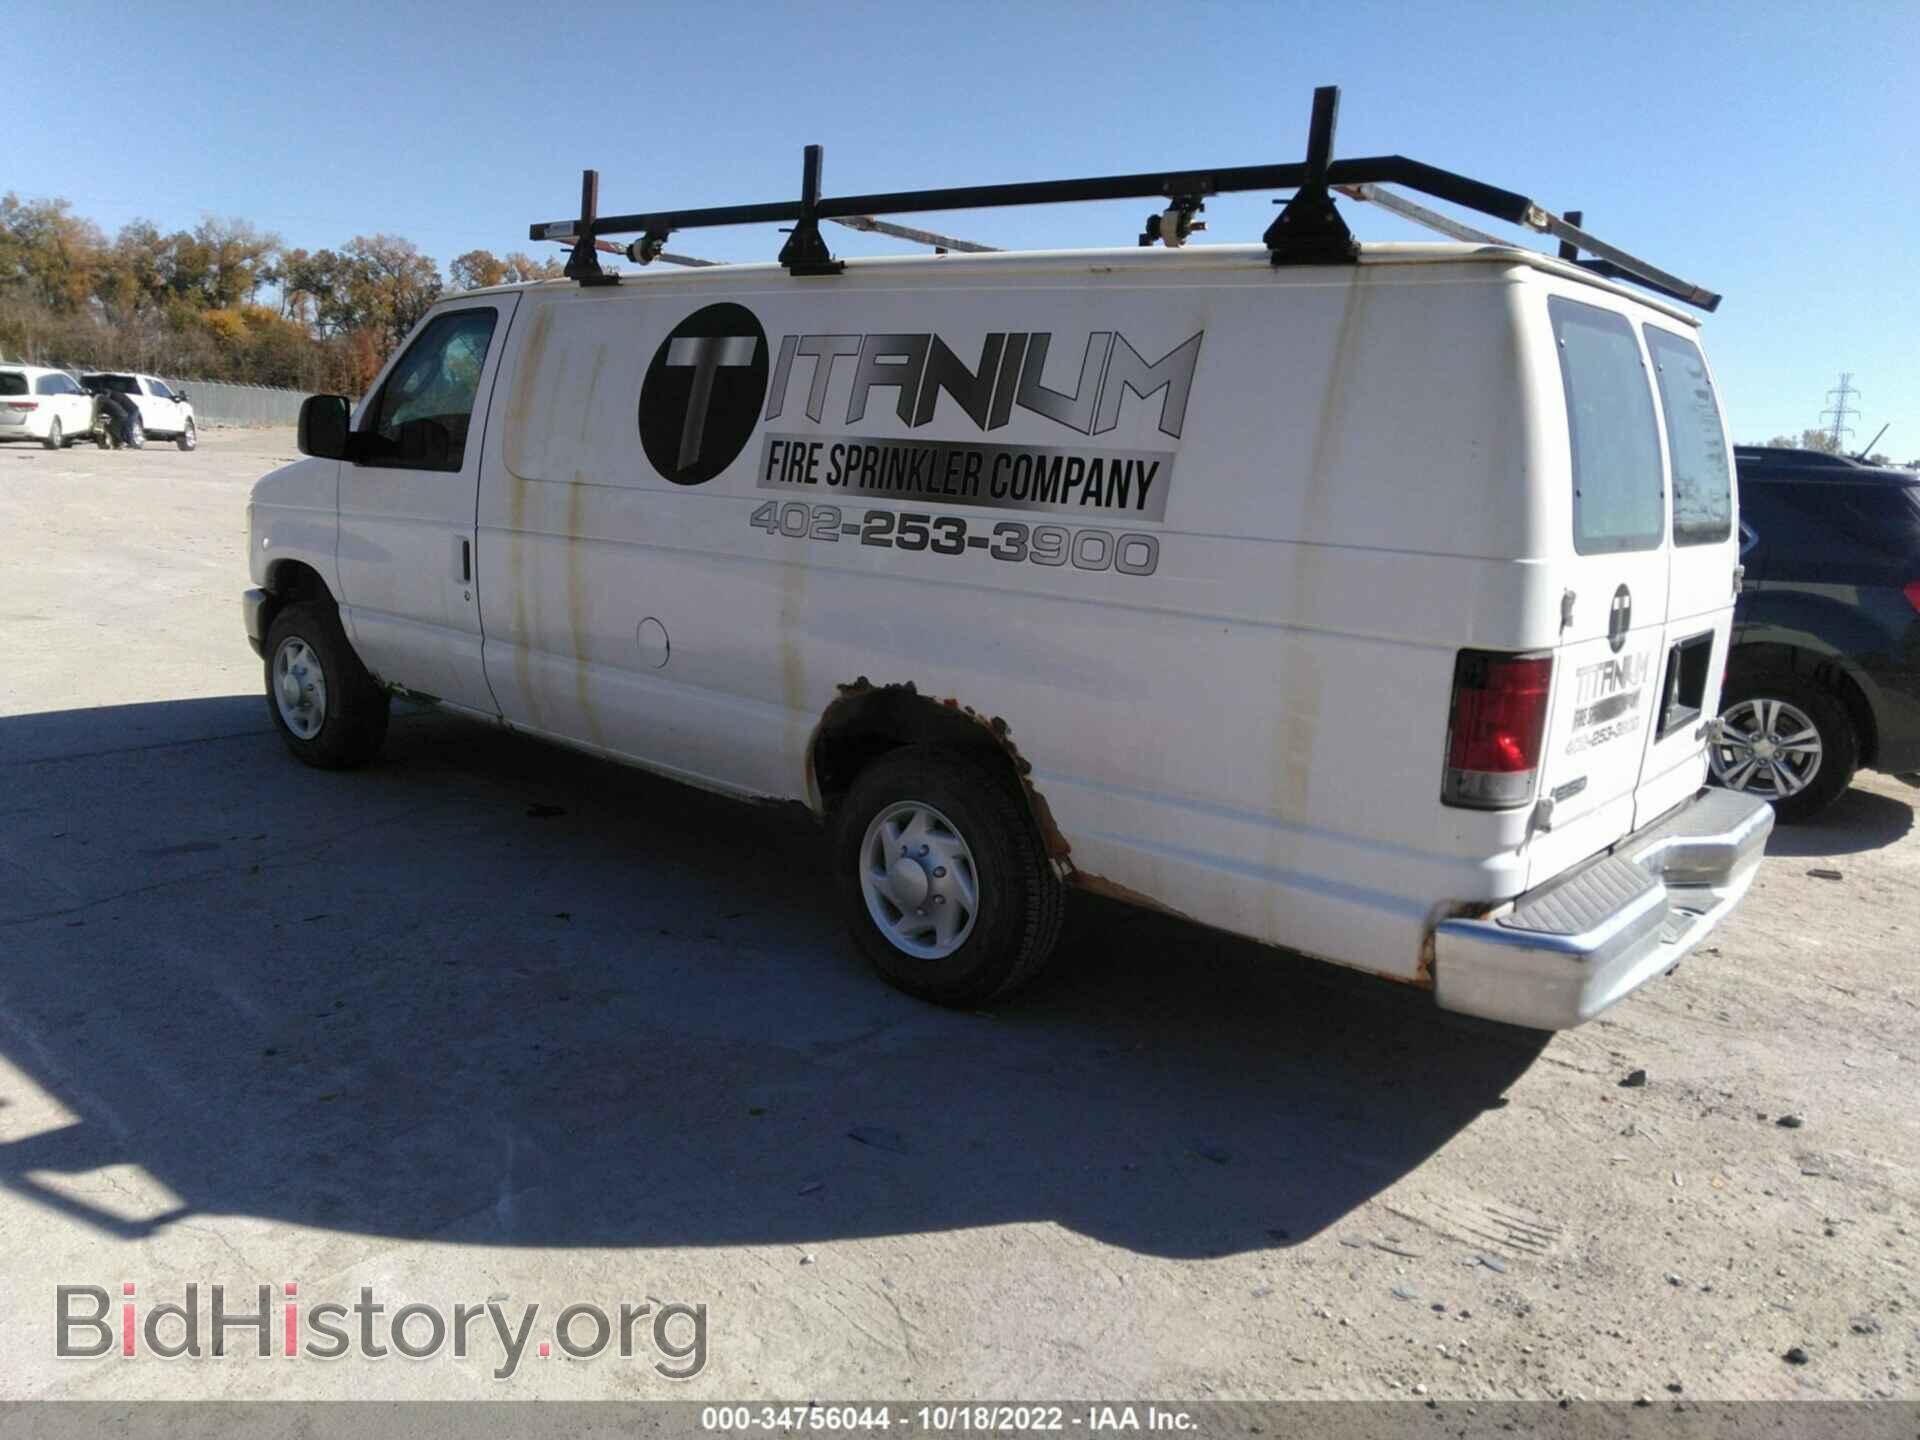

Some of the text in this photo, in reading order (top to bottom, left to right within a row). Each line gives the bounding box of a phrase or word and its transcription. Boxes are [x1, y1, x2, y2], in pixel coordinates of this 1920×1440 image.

[766, 440, 1160, 511] FIRE SPRINKLER COMPANY
[749, 500, 1160, 577] 402-253-3900
[1576, 651, 1649, 705] TITANIUM
